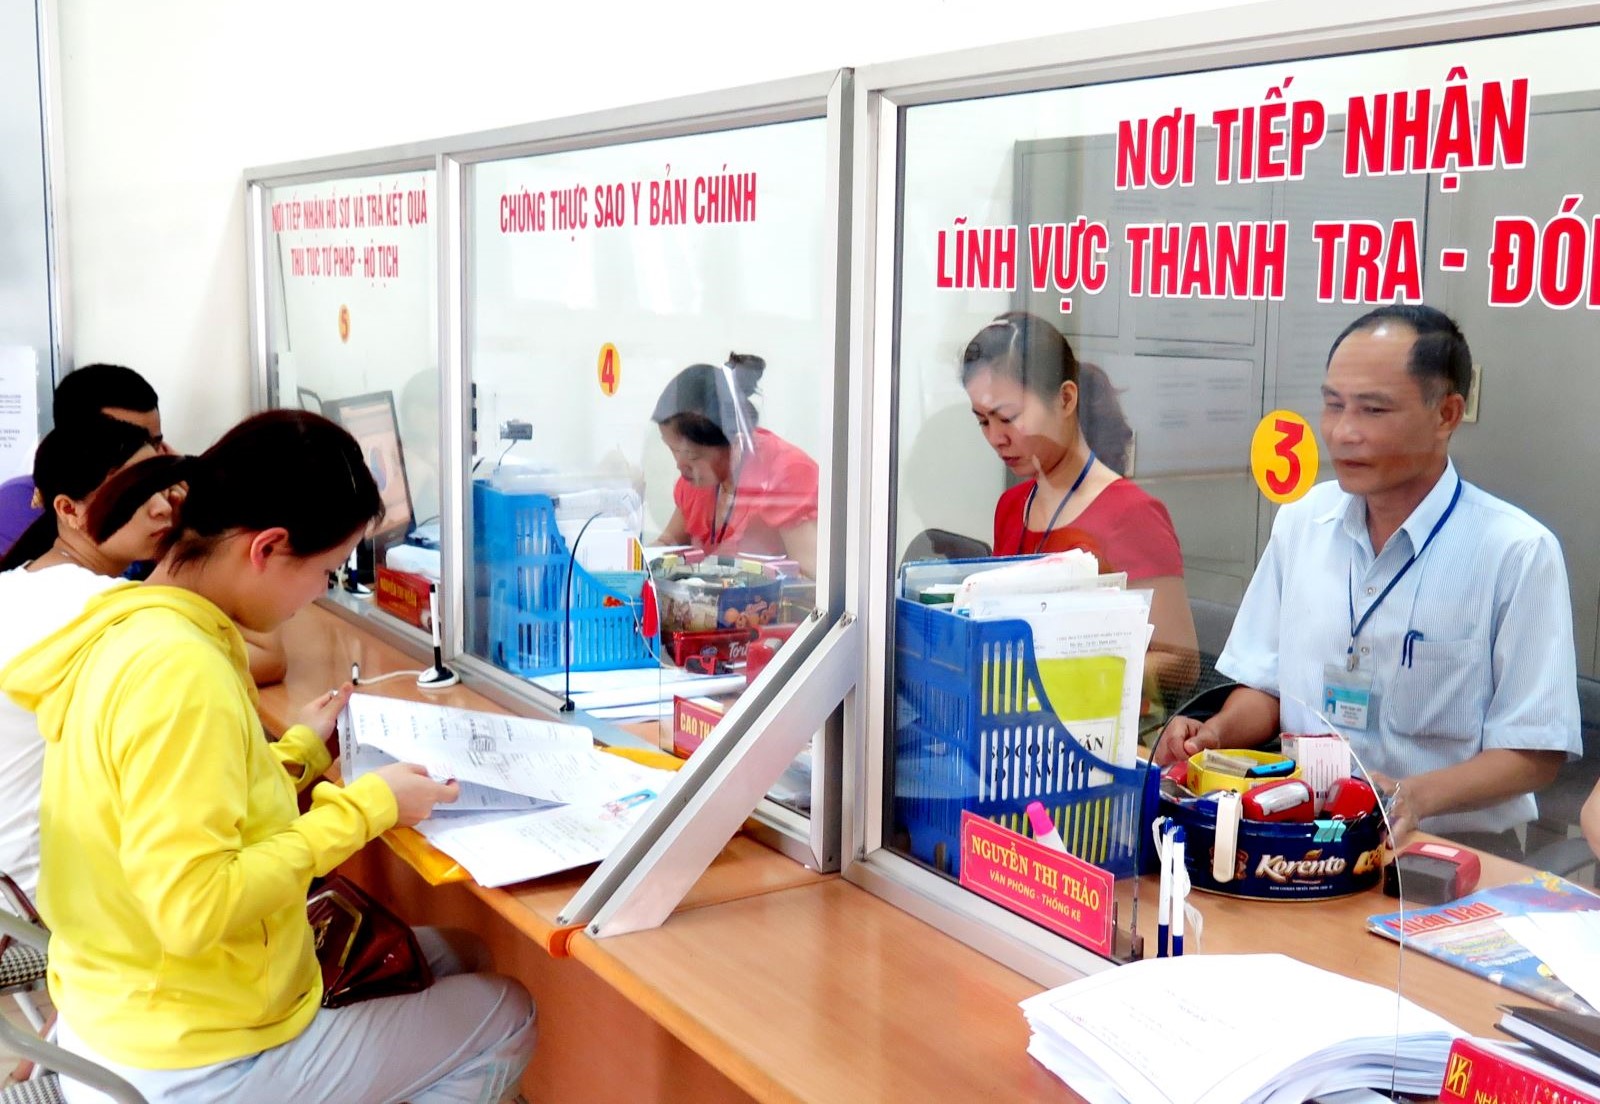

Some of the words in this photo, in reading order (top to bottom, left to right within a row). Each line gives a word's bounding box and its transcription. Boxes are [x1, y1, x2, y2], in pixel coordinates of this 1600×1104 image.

[1115, 107, 1196, 190] NƠI
[1213, 76, 1326, 184] TIẾP
[1343, 66, 1529, 192] NHẬN
[339, 195, 350, 229] SƠ
[353, 188, 365, 228] VÀ
[366, 181, 384, 227] TRẢ
[386, 180, 403, 226] KẾT
[407, 176, 428, 229] QUẢ
[500, 184, 545, 233] CHỨNG
[550, 183, 588, 242] THỰC
[595, 182, 625, 228] SAO
[631, 181, 641, 226] Y
[649, 163, 687, 226] BẢN
[694, 163, 757, 225] CHÍNH
[333, 239, 355, 277] PHÁP
[363, 238, 376, 288] HỘ
[377, 244, 399, 289] TỊCH
[936, 216, 1017, 292] LĨNH
[1029, 215, 1108, 312] VỰC
[1126, 220, 1289, 300] THANH
[1313, 218, 1423, 304] TRA
[341, 308, 349, 340] 5
[601, 349, 615, 394] 4
[1265, 418, 1304, 495] 3
[680, 712, 698, 737] CAO
[971, 834, 1029, 877] NGUYỄN
[1032, 860, 1059, 895] THỊ
[1061, 876, 1100, 912] THẢO
[1255, 853, 1347, 883] Korento
[989, 869, 1006, 885] VĂN
[1007, 877, 1036, 900] PHÒNG
[1041, 892, 1070, 916] THỐNG
[1071, 907, 1082, 923] KÊ
